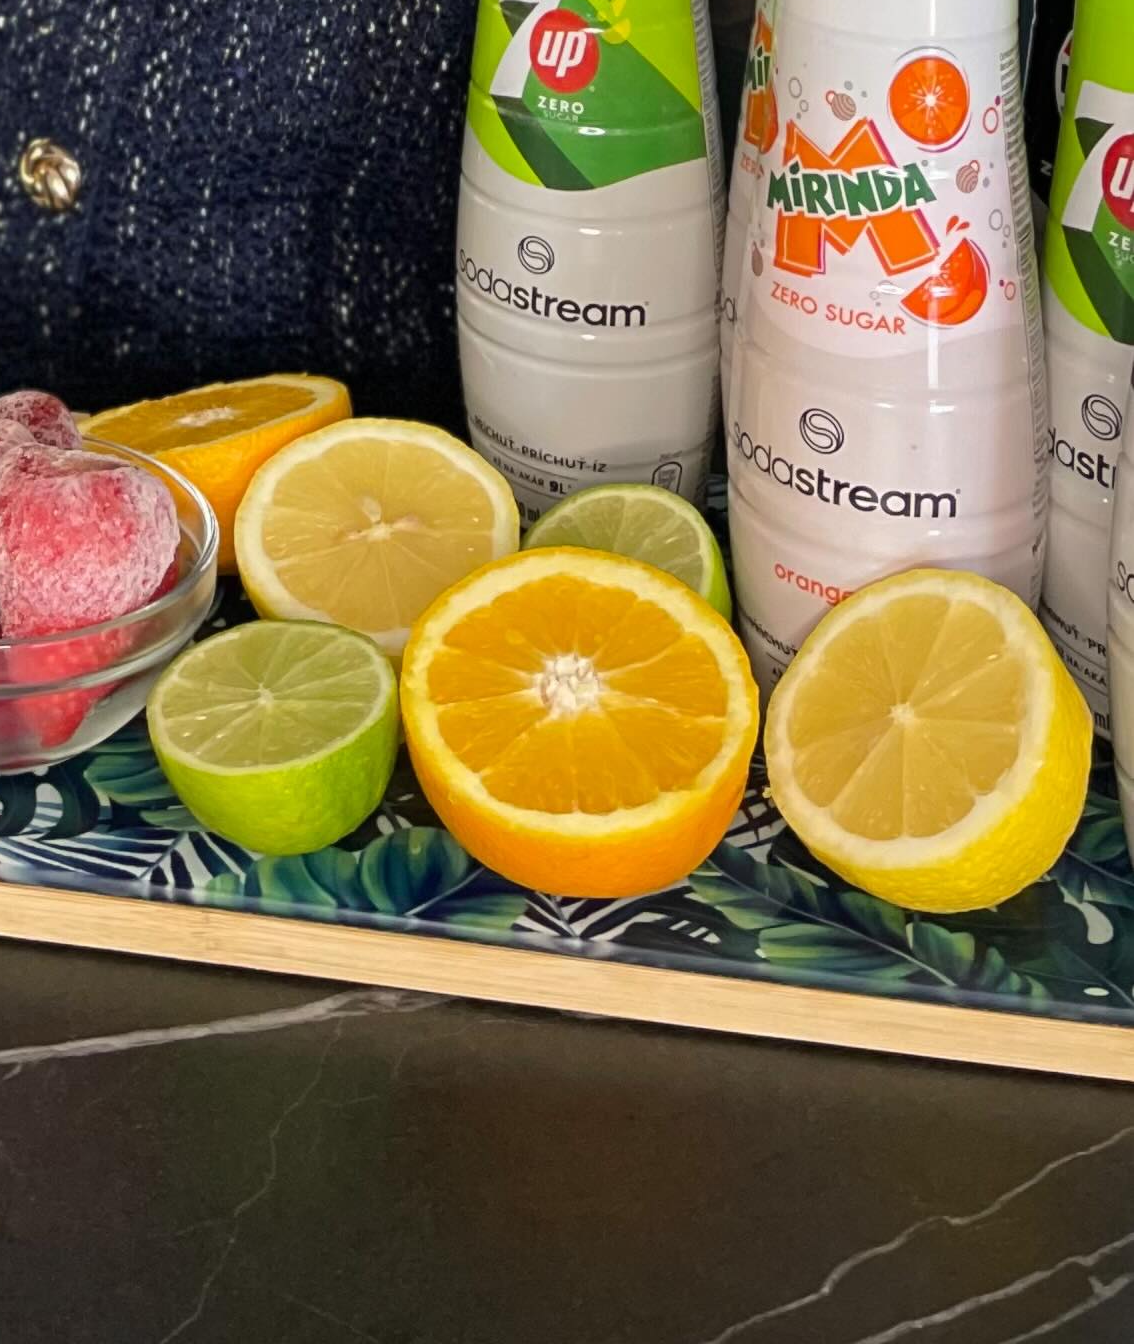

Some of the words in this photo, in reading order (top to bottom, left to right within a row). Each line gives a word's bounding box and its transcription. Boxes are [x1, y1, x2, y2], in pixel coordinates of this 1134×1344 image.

[538, 96, 584, 114] ZERO
[459, 248, 646, 327] sodastream
[770, 281, 818, 314] ZERO
[825, 303, 906, 335] SUGAR
[733, 421, 957, 518] sodastream
